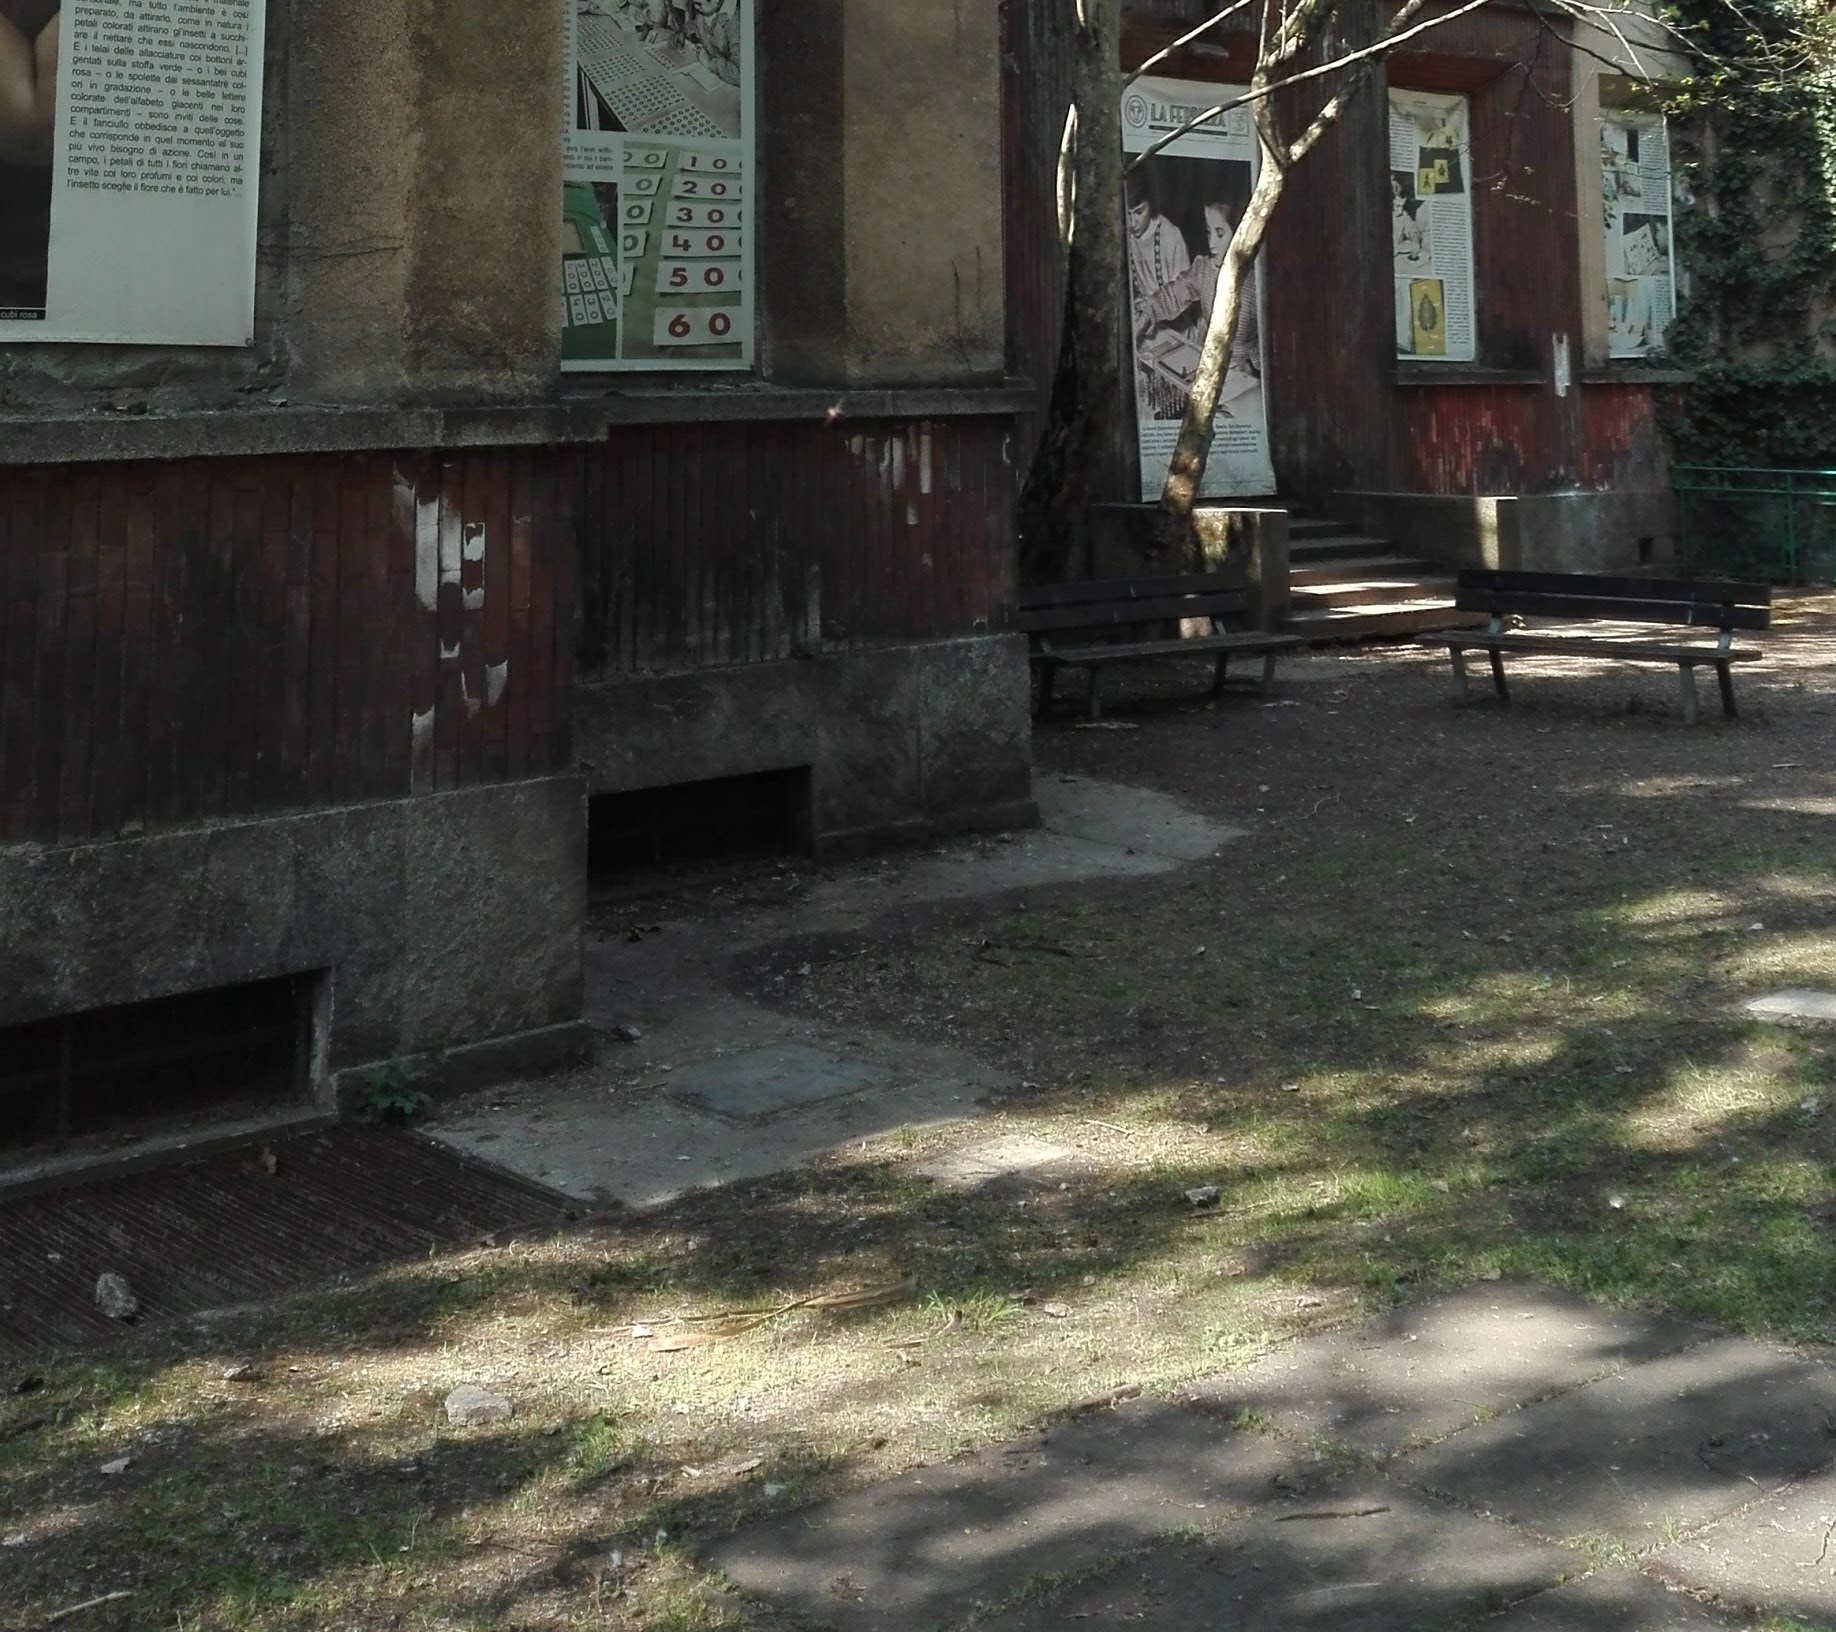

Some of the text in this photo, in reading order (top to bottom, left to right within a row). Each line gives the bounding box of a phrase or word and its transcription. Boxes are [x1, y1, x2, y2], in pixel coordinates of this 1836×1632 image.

[138, 48, 185, 60] allacciature
[113, 95, 164, 107] dell'alfabeto
[70, 105, 131, 117] compartimenti
[1151, 103, 1166, 122] LA
[194, 126, 245, 138] quell'oggetto
